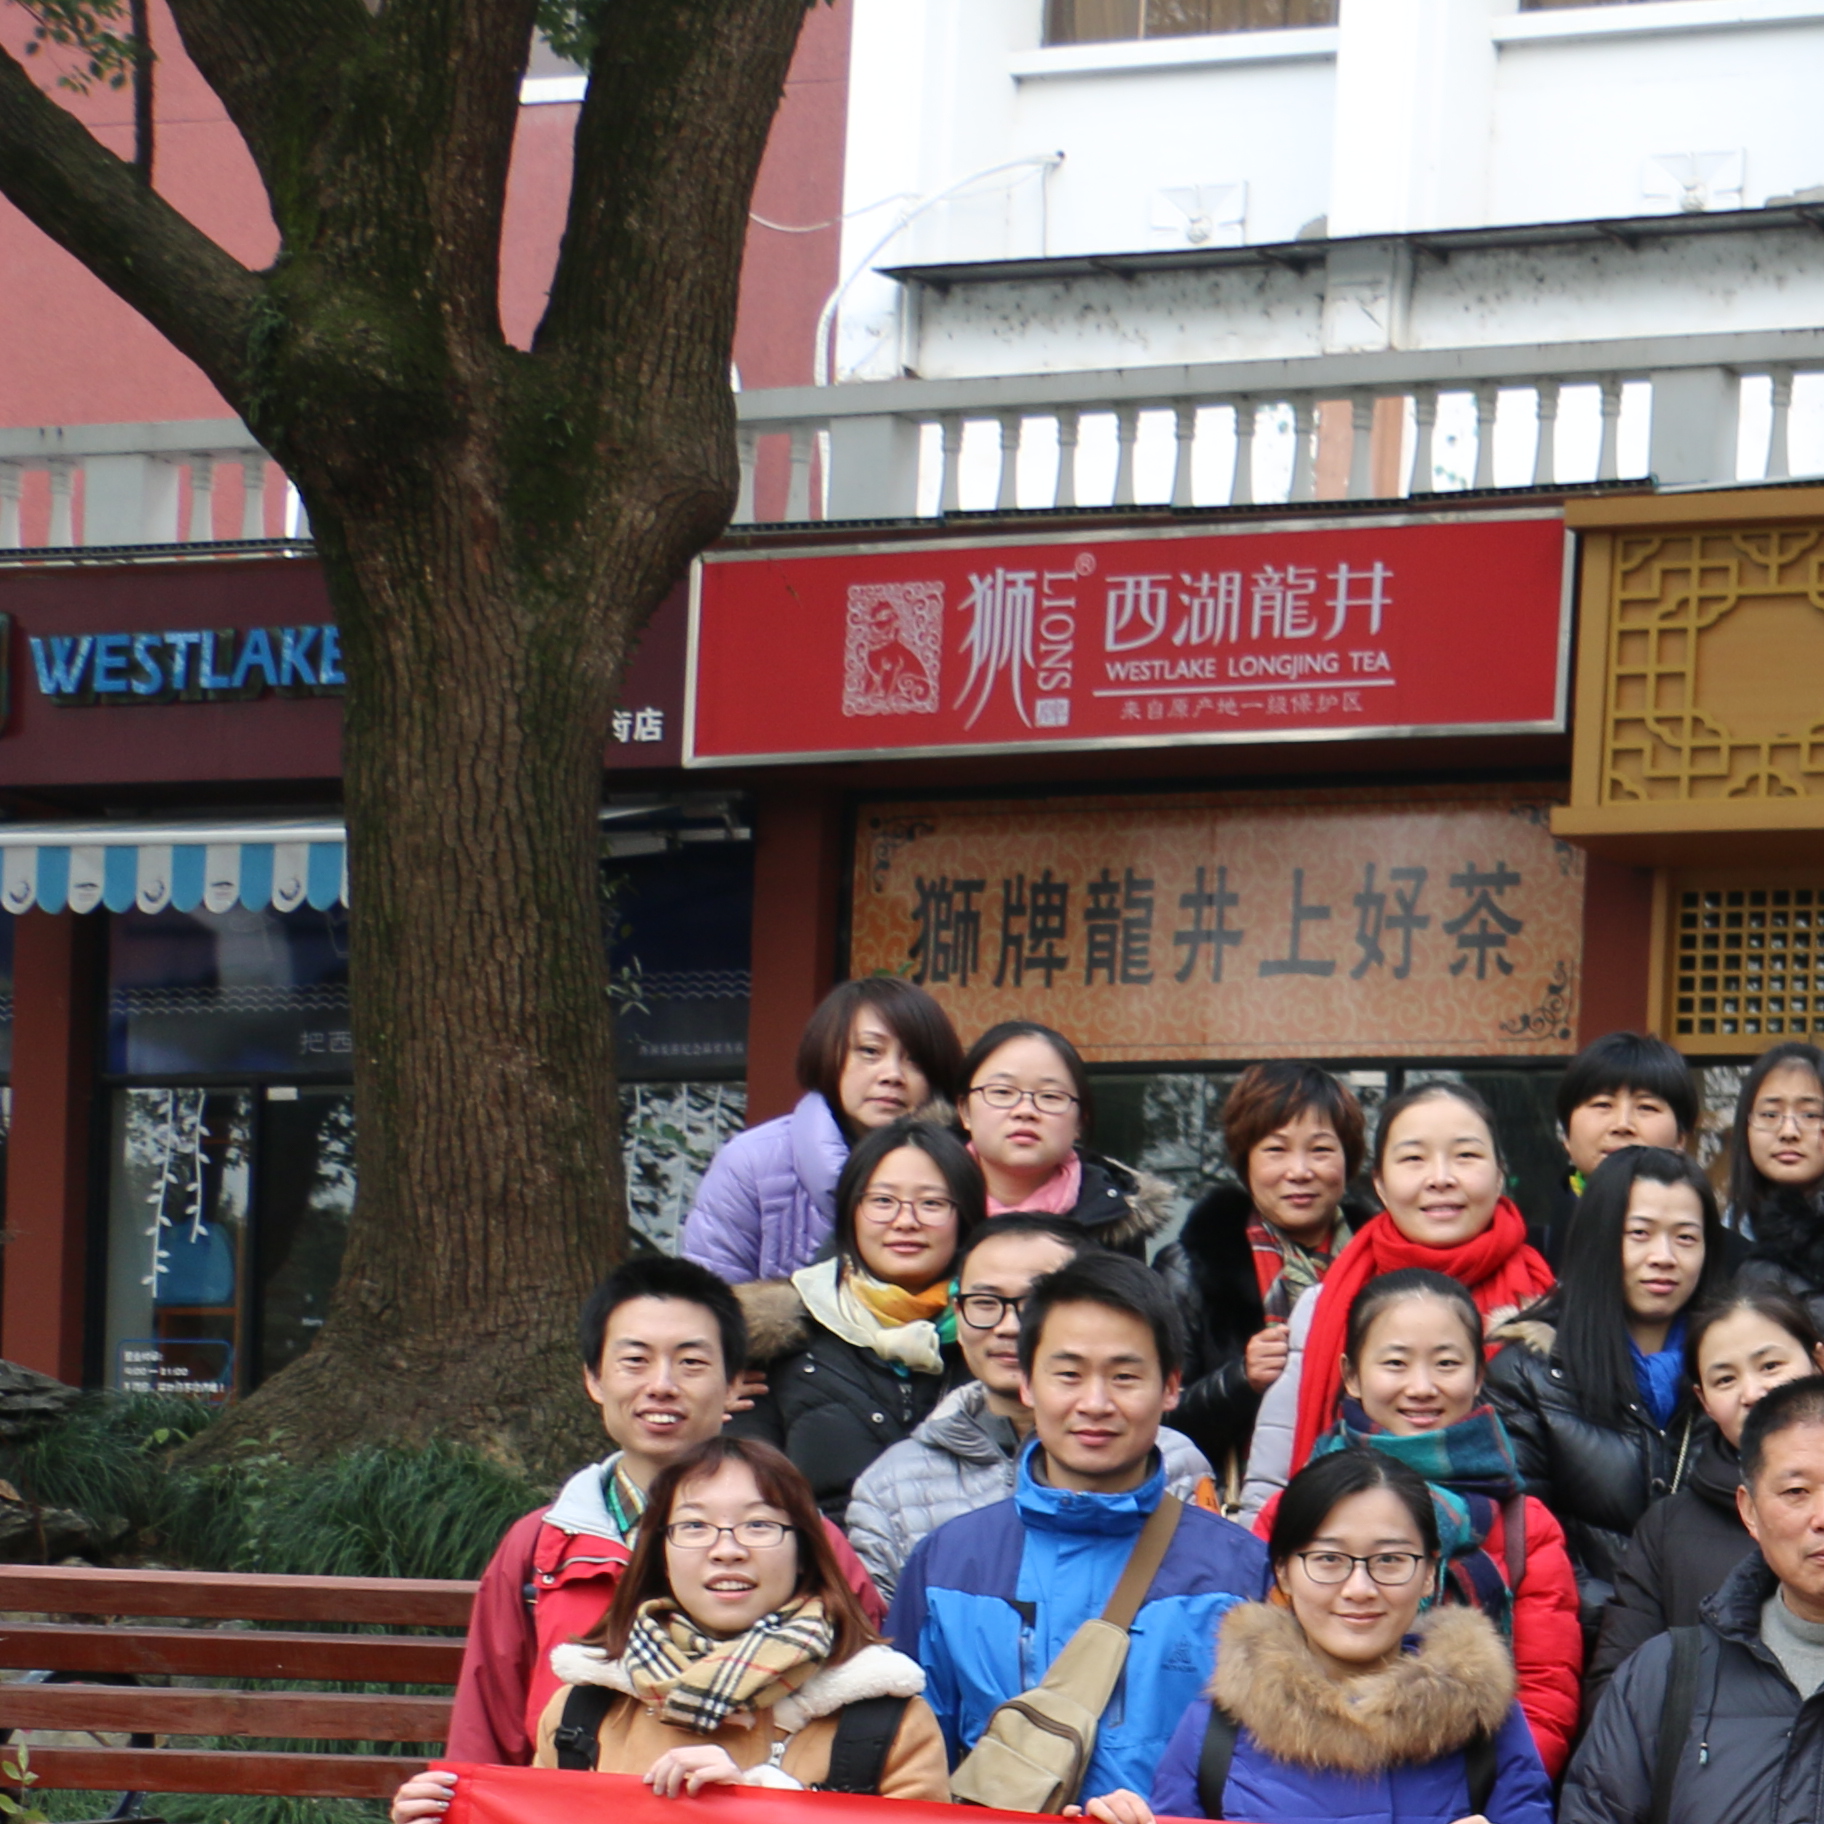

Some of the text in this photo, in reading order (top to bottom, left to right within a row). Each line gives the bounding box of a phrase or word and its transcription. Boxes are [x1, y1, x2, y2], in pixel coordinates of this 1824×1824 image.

[952, 567, 1037, 731] 狮
[1037, 570, 1078, 692] LIONS
[1105, 560, 1394, 653] 西湖龍井
[1106, 650, 1391, 683] WESTLAKE LONGJING TEA
[909, 860, 1526, 990] 獅牌龍井上好茶
